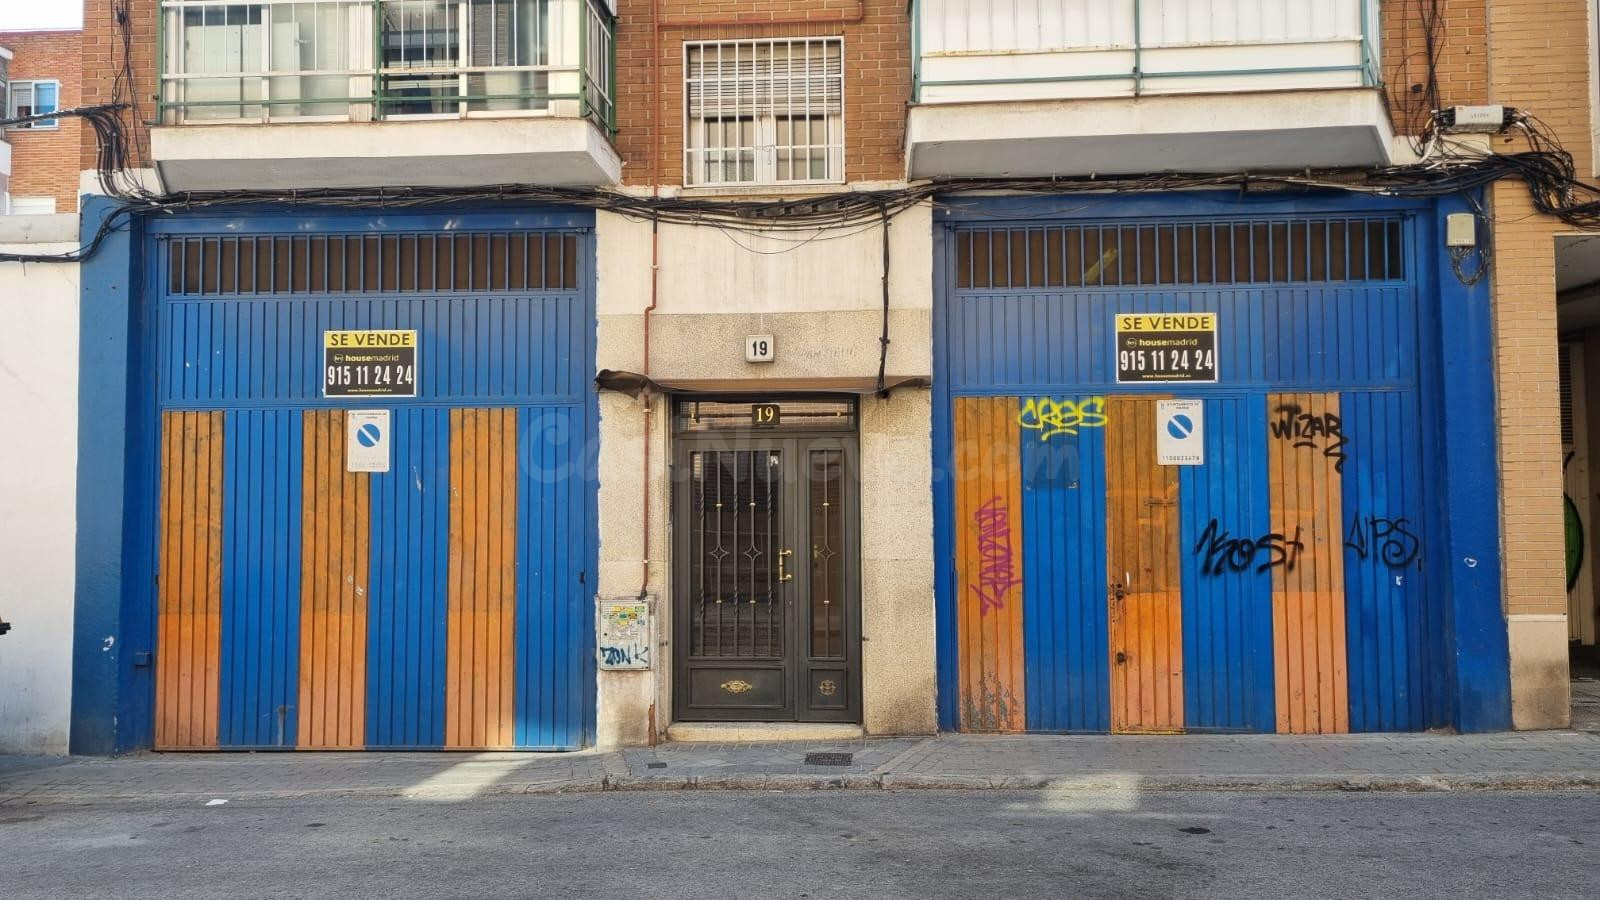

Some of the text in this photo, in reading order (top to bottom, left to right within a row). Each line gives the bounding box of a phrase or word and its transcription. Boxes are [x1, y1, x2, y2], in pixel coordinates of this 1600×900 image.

[1123, 316, 1210, 330] SE VENDE
[330, 333, 410, 346] SE VENDE
[752, 340, 769, 357] 19
[1120, 349, 1213, 371] 915 11 24 24
[327, 364, 413, 386] 915 11 24 24
[757, 406, 774, 422] 19
